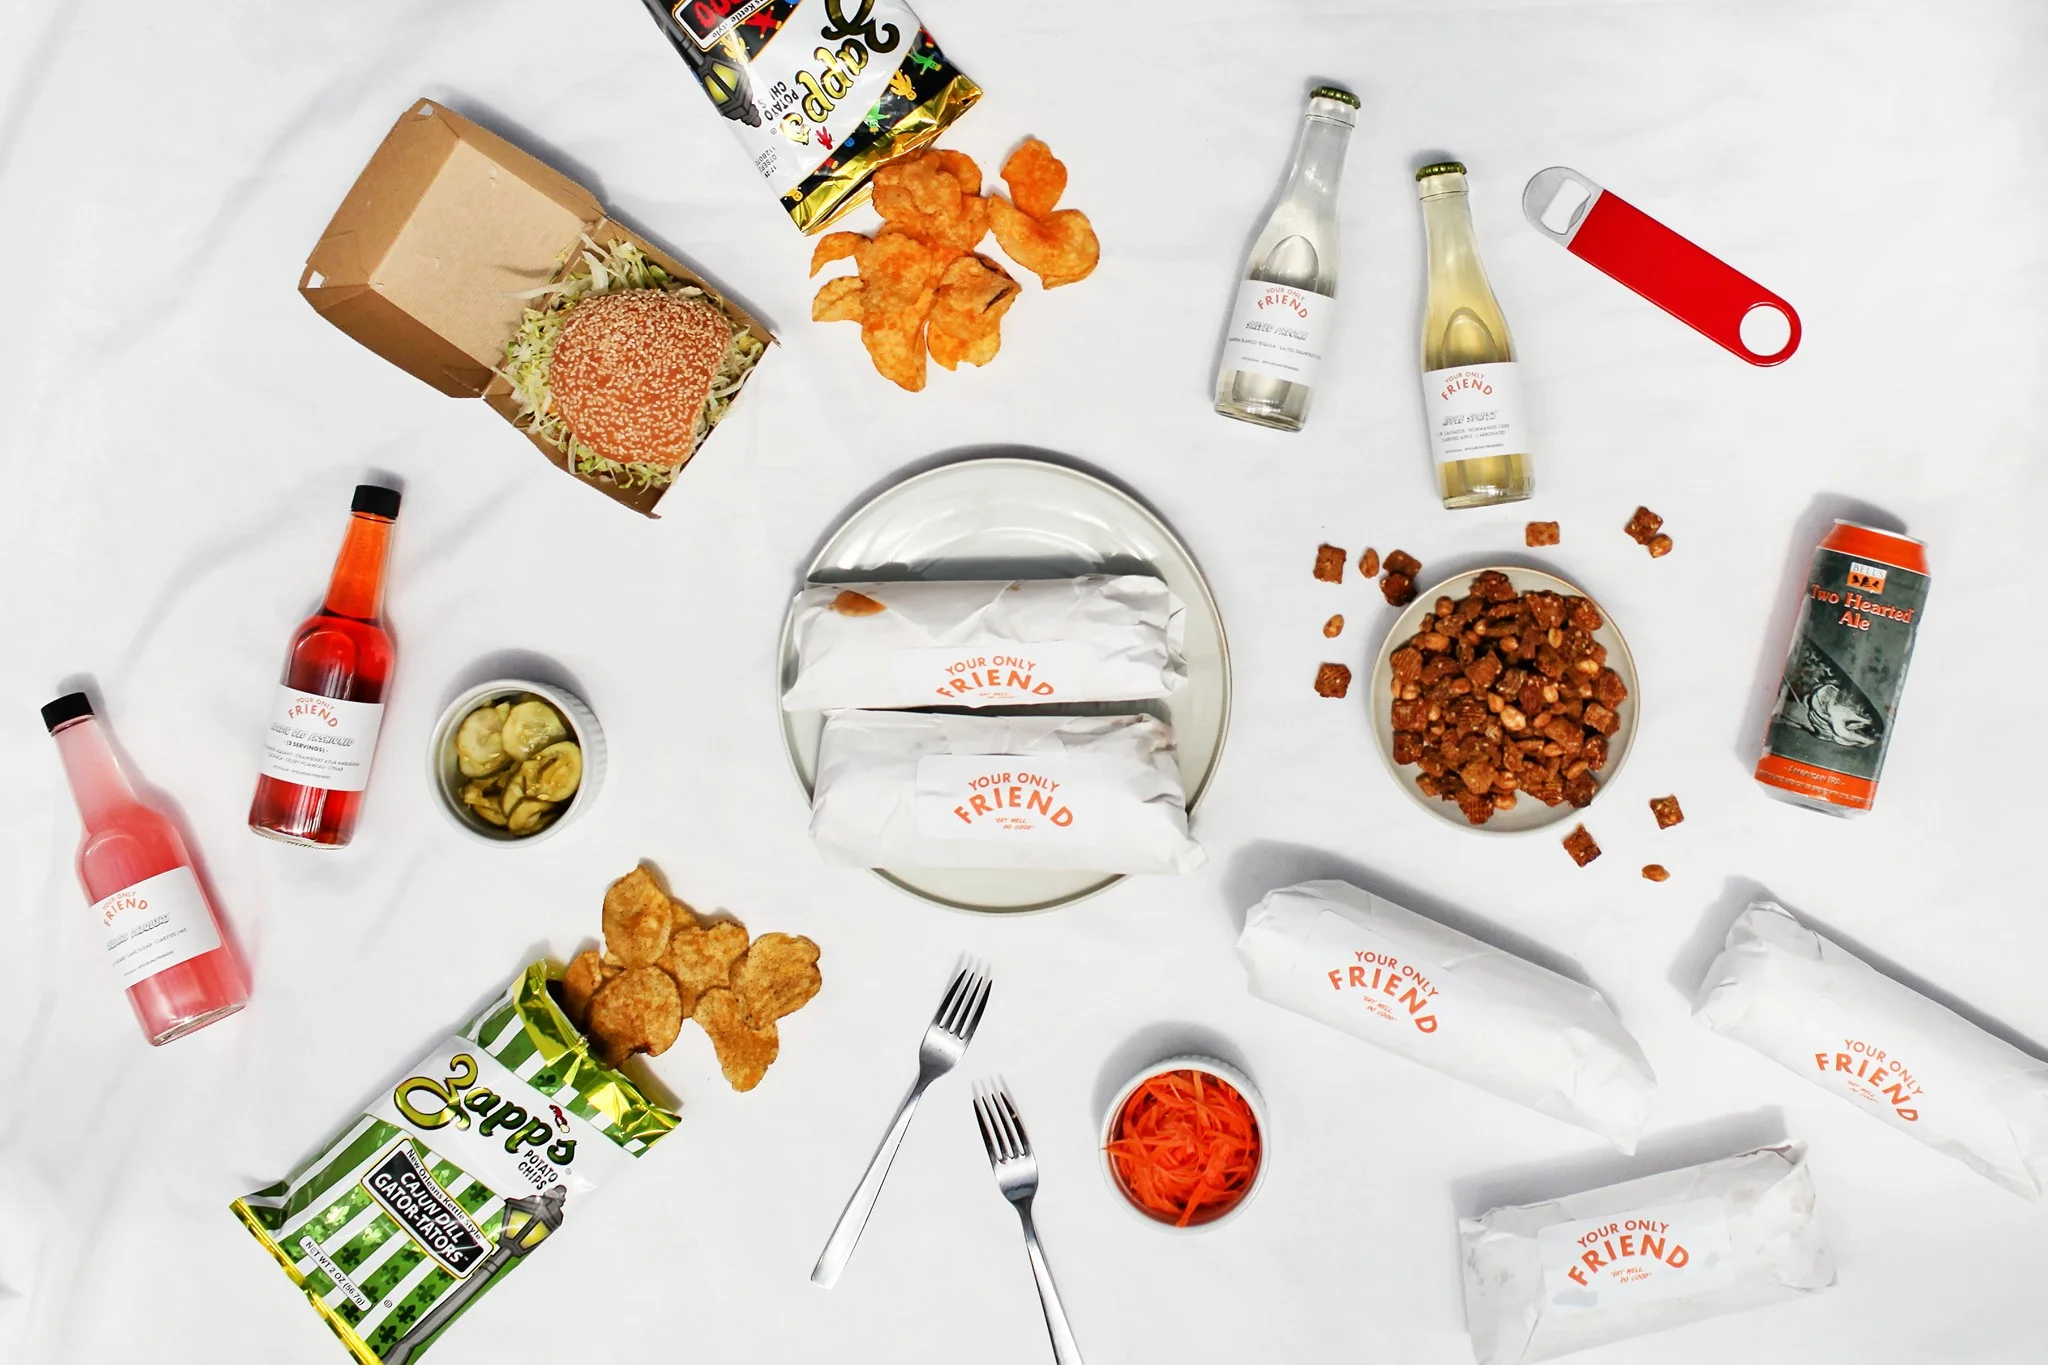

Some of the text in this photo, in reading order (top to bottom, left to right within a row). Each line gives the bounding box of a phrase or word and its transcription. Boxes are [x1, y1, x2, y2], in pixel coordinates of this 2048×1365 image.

[711, 15, 732, 38] tyle
[757, 81, 787, 109] CHIS
[764, 88, 800, 121] POTATO
[1257, 294, 1308, 319] FRIEND
[1266, 287, 1305, 300] YOUR ONLY
[1441, 378, 1493, 401] FRIEND
[1445, 371, 1485, 384] YOUR ONLY
[1811, 584, 1914, 624] Two Hearted
[1838, 610, 1871, 631] Ale
[945, 655, 1036, 676] YOUR ONLY
[936, 669, 1055, 698] FRIEND
[288, 704, 338, 728] FRIEND
[316, 699, 335, 711] ONLY
[968, 772, 1060, 793] YOUR ONLY
[953, 786, 1074, 827] FRIEND
[117, 891, 136, 899] ONLY
[103, 898, 148, 927] FRIEND
[1355, 951, 1439, 997] YOUR ONLY
[1327, 965, 1438, 1034] FRIEND
[1845, 1039, 1887, 1063] YOUR
[1889, 1060, 1924, 1095] ONLY
[1815, 1053, 1919, 1122] FRIEND
[394, 1053, 578, 1165] Zapp's
[518, 1161, 547, 1190] CHIPS
[524, 1149, 559, 1183] POTATO
[400, 1172, 465, 1243] CAJUN DILL
[407, 1148, 481, 1240] New Orleans Kettle Style
[374, 1173, 464, 1263] GATOR-TATORS
[1577, 1219, 1669, 1248] YOUR ONLY
[305, 1241, 320, 1257] NET
[319, 1254, 331, 1268] WT
[334, 1272, 346, 1283] OZ
[1568, 1234, 1689, 1287] FRIEND
